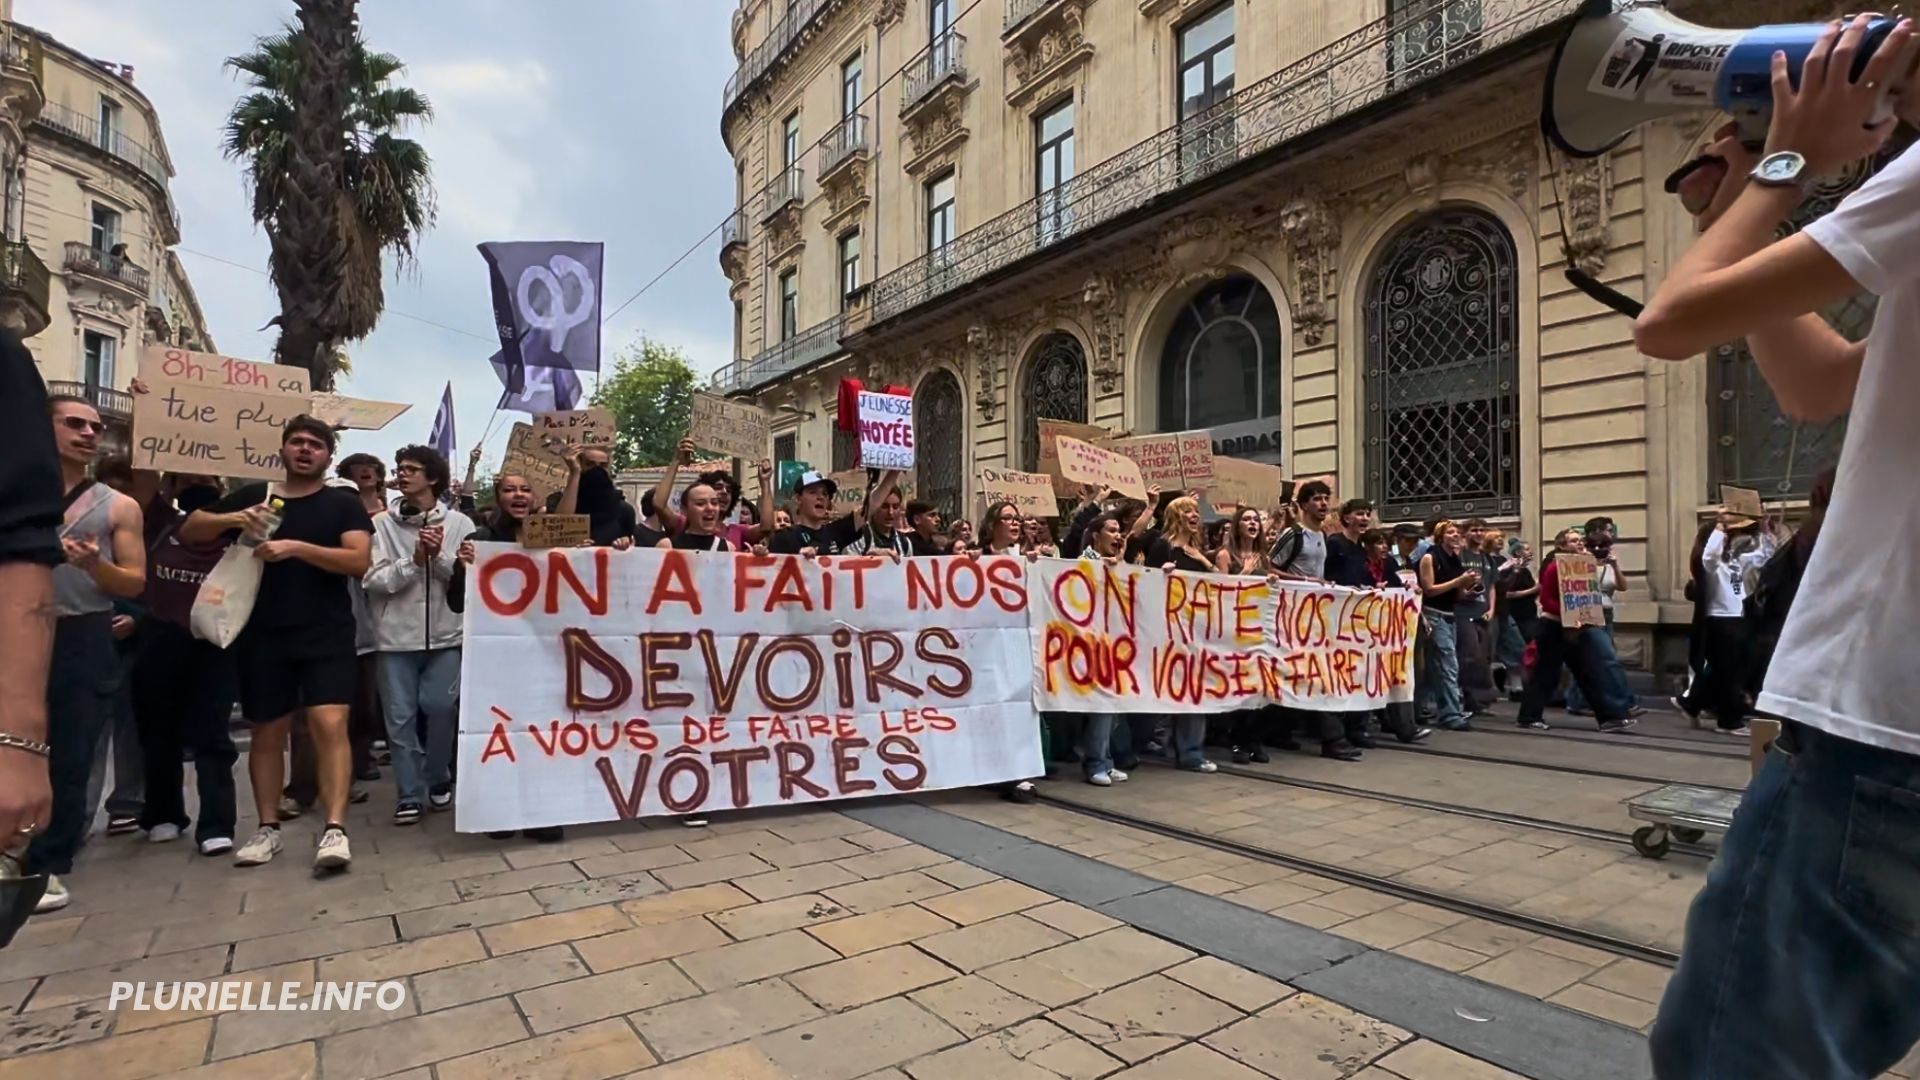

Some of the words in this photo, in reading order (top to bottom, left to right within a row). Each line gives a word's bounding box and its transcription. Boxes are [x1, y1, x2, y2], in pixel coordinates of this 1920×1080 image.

[1664, 42, 1732, 57] RIPOSTE
[278, 378, 303, 393] ça
[161, 387, 218, 423] tue
[236, 401, 289, 430] plu
[859, 394, 912, 415] JEUNESSE
[140, 433, 226, 465] qu'une
[235, 437, 287, 470] tum
[859, 418, 913, 448] NOYÉE
[1124, 446, 1138, 458] DE
[1182, 454, 1198, 466] PAS
[479, 549, 608, 616] ON
[645, 550, 702, 616] A
[906, 556, 1027, 613] NOS
[1054, 565, 1137, 639] ON
[1166, 575, 1267, 645] RATE
[1045, 625, 1140, 695] POUR
[1152, 640, 1230, 706] VOUS
[1225, 651, 1282, 701] EN
[1284, 649, 1363, 697] FAIRE
[481, 705, 516, 764] À
[528, 719, 660, 757] VOUS
[682, 715, 727, 745] DE
[880, 706, 958, 735] LES
[595, 734, 928, 820] VÔTRES
